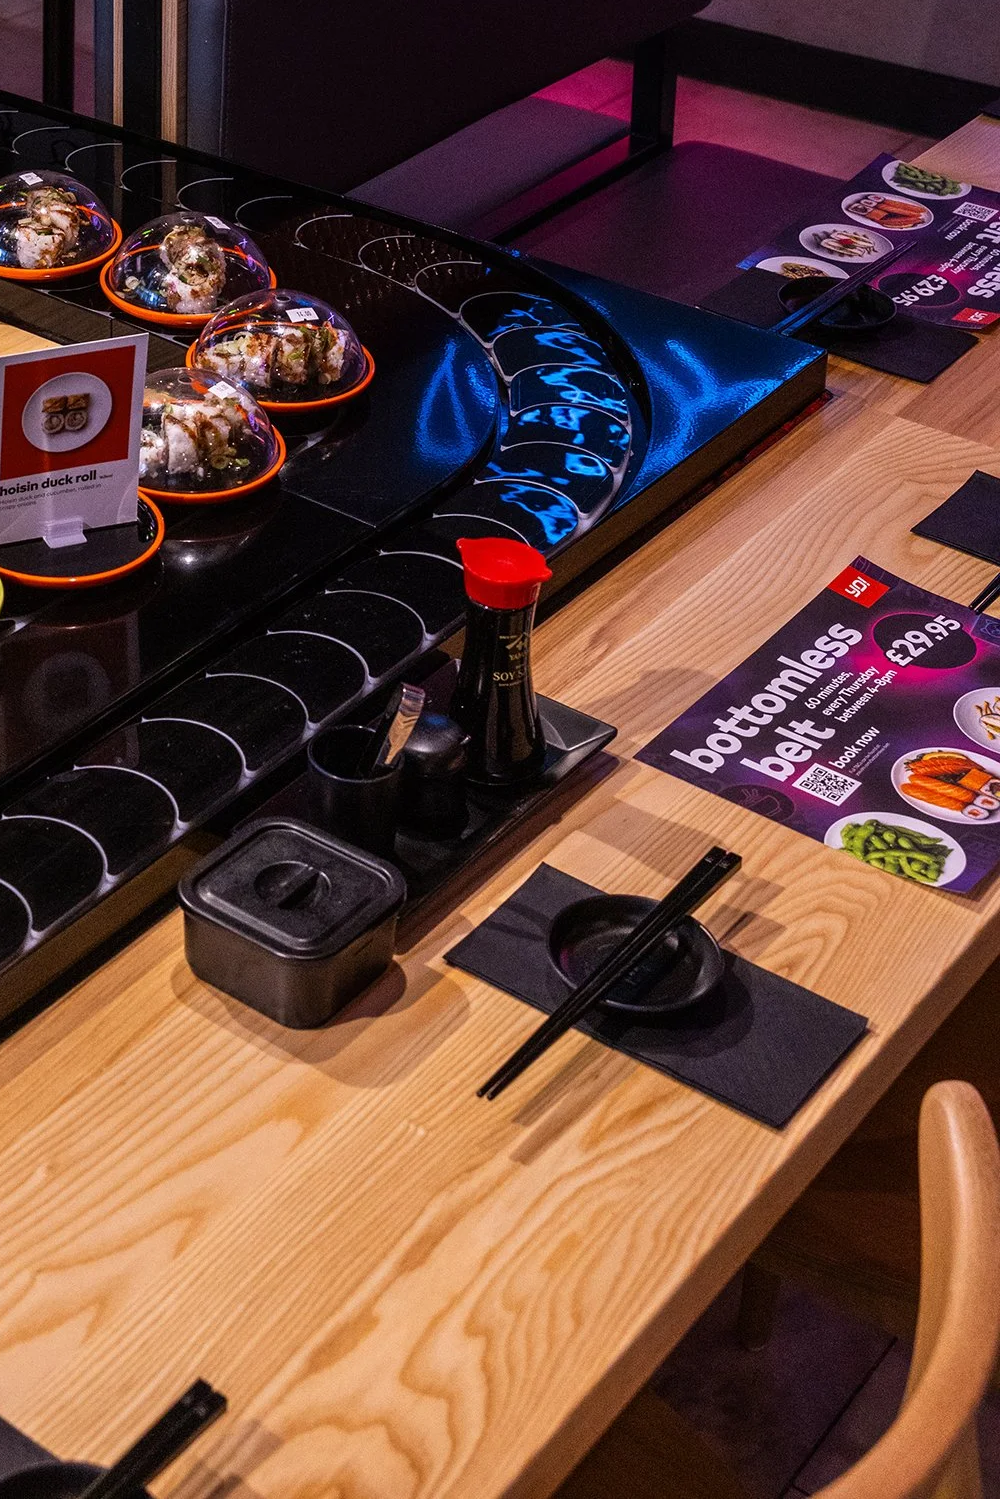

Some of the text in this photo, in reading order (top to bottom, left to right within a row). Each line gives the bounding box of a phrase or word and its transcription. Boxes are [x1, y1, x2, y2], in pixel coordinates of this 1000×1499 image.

[892, 274, 948, 306] £29.95
[0, 469, 97, 497] hoisin duck roll
[886, 614, 961, 667] £29.95
[492, 671, 516, 681] SOY
[804, 671, 854, 709] 60 minutes,
[822, 666, 880, 715] every Thursday
[670, 623, 863, 774] bottomless
[834, 692, 874, 723] between
[739, 719, 836, 783] belt
[828, 745, 862, 769] book
[855, 726, 880, 747] now
